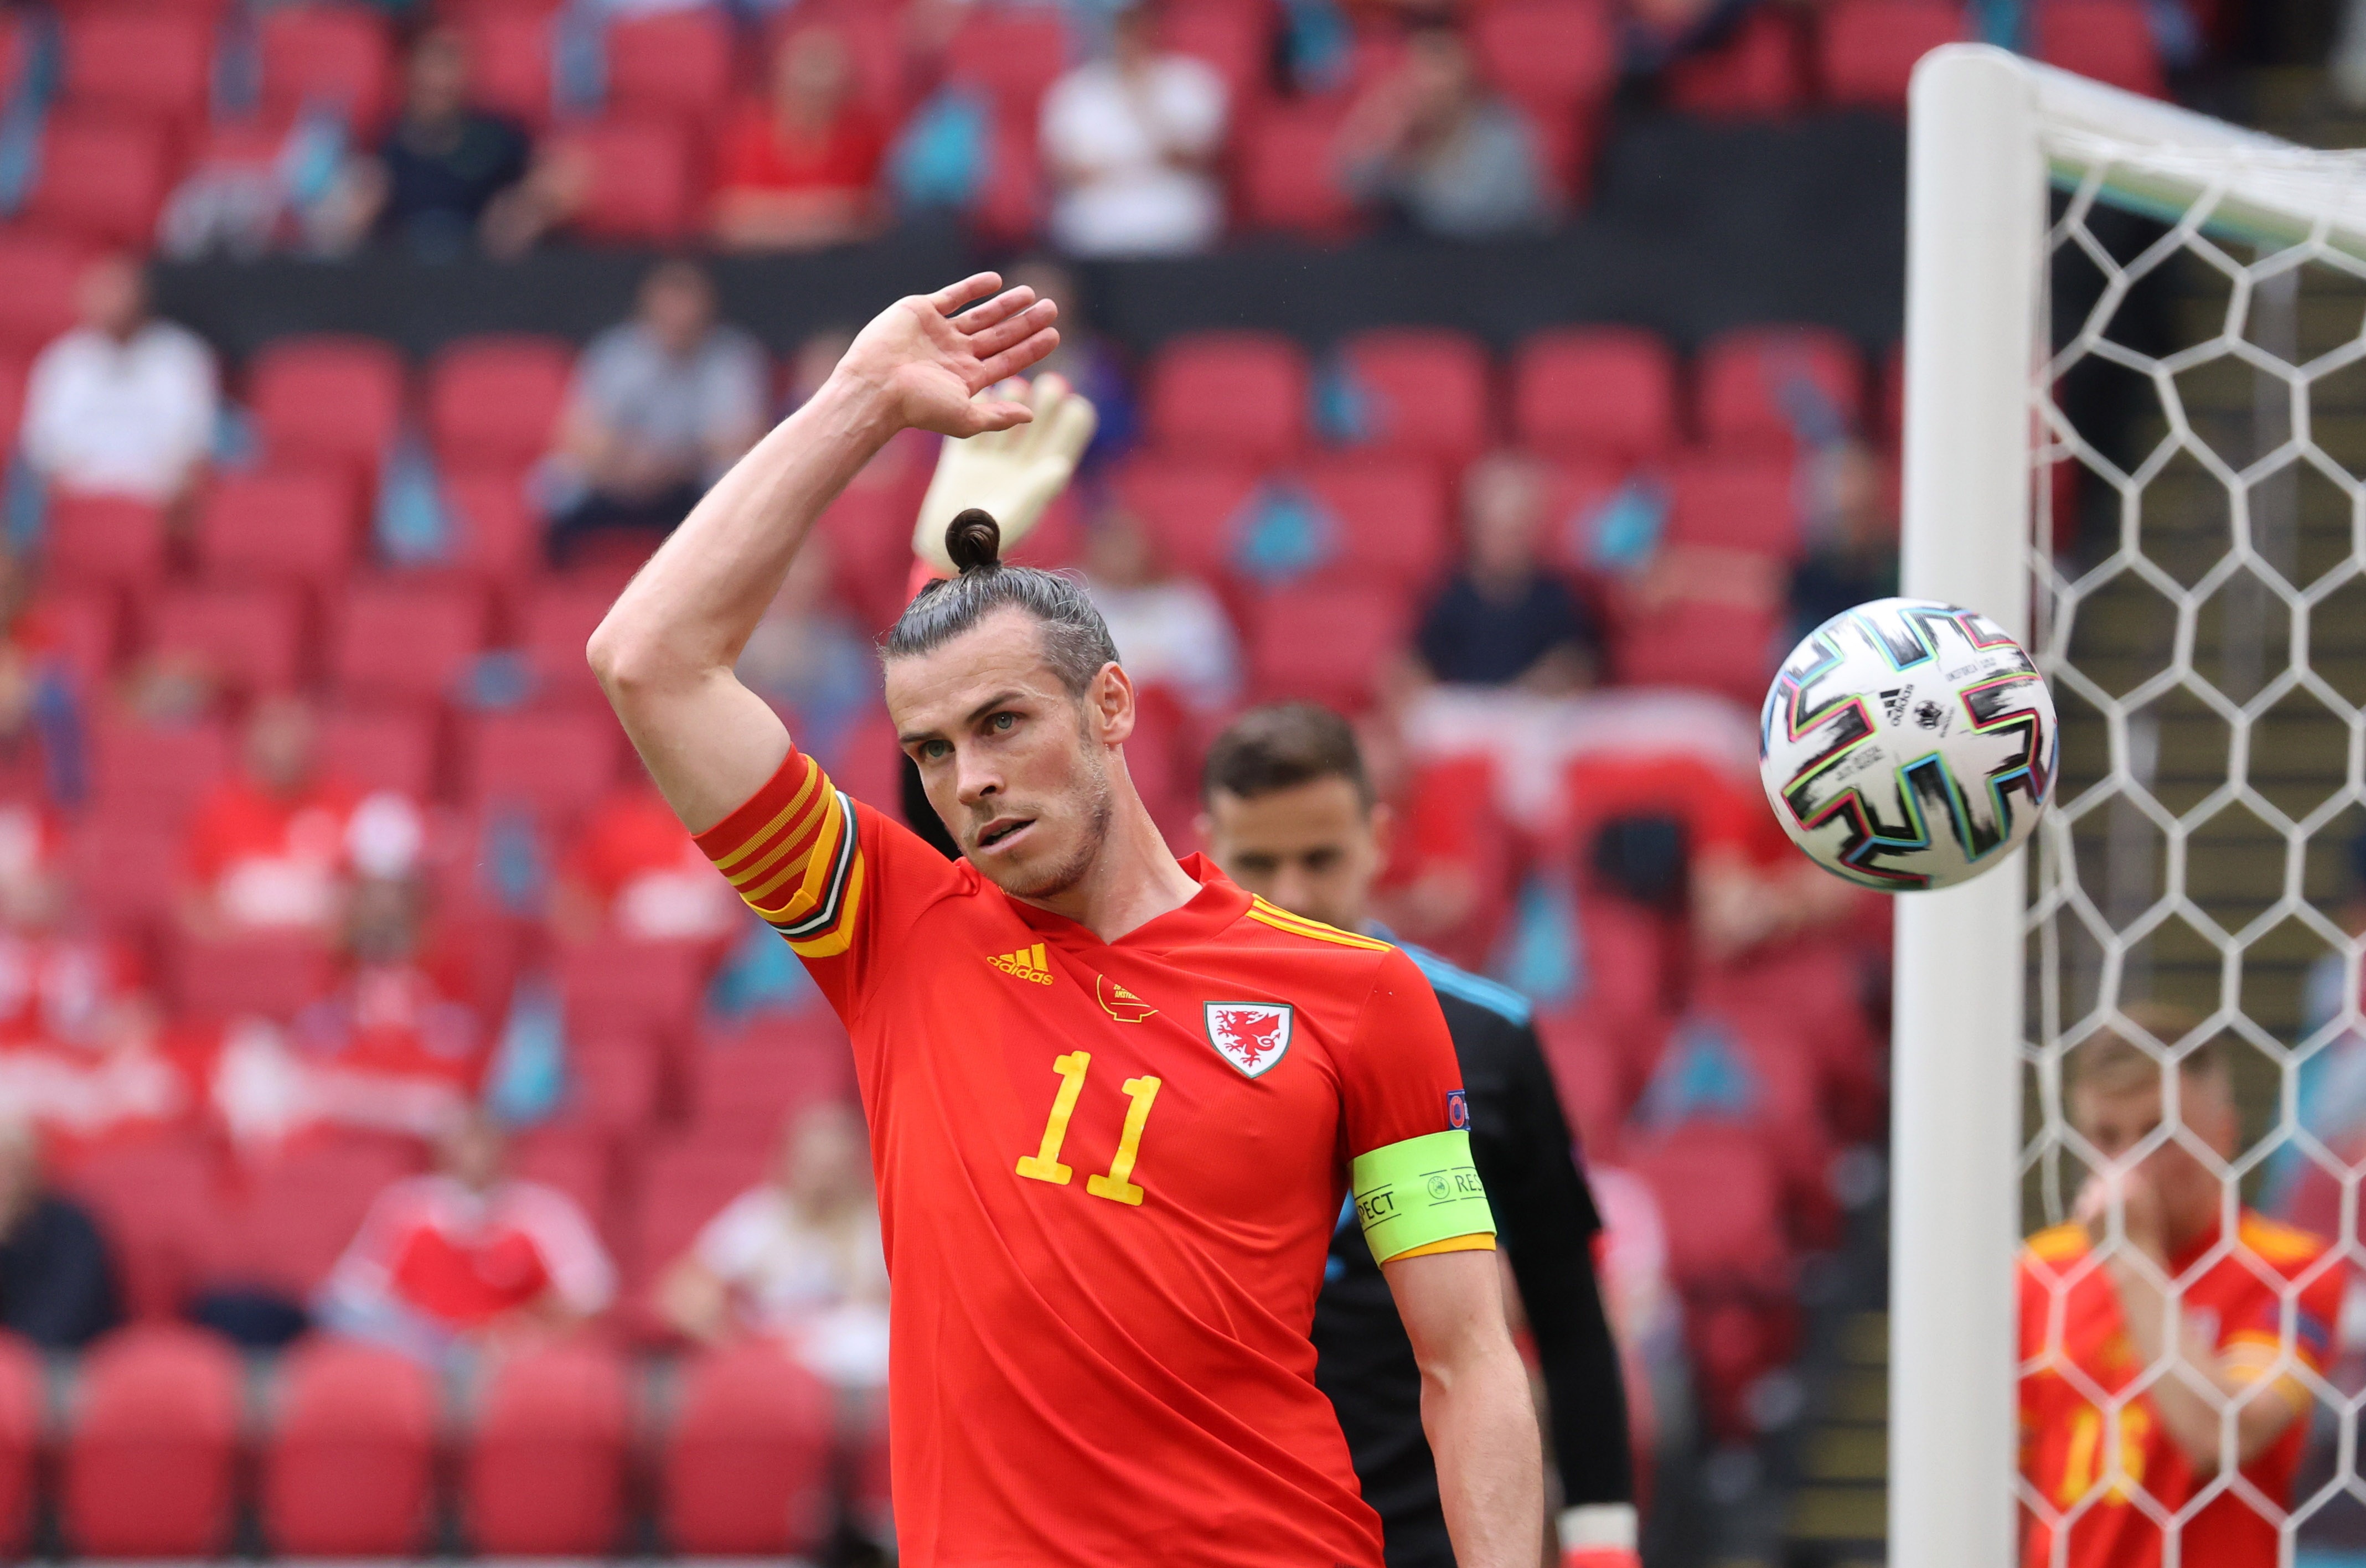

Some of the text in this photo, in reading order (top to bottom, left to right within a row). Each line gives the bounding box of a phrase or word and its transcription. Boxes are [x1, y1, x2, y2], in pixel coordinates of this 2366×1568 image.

[1890, 683, 1915, 727] adidas
[986, 956, 1054, 986] adidas
[1015, 1050, 1162, 1207] 11
